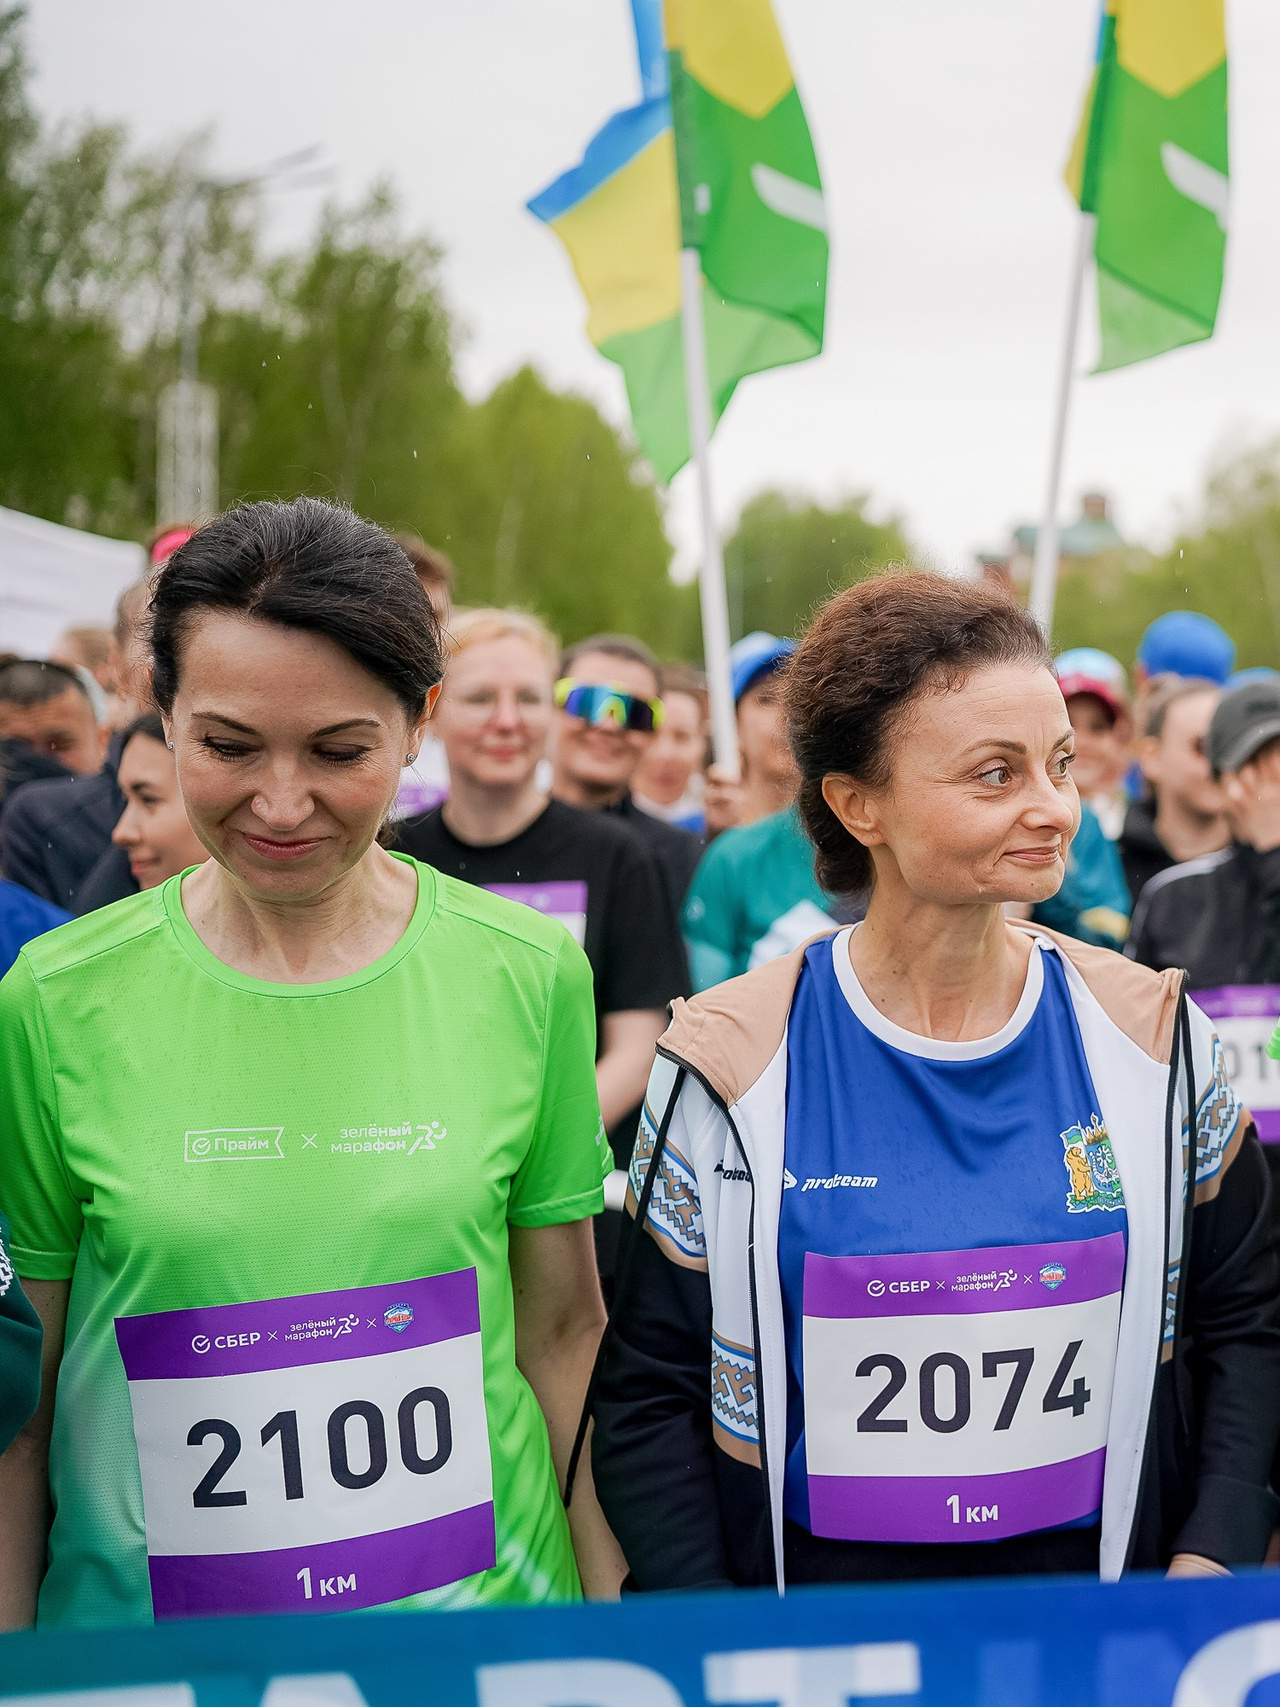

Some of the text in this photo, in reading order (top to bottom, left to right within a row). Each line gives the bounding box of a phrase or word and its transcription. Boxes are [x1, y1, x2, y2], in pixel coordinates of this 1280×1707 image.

[339, 1121, 412, 1139] зелёный
[214, 1136, 270, 1152] Прайм
[330, 1138, 407, 1155] марафон
[801, 1173, 879, 1192] proteam
[955, 1270, 998, 1284] зелёный
[888, 1280, 931, 1294] СБЕР
[950, 1281, 995, 1295] марафон
[289, 1316, 337, 1332] зелёный
[214, 1331, 261, 1349] СБЕР
[284, 1328, 333, 1342] марафон
[854, 1339, 1092, 1434] 2074
[185, 1386, 454, 1509] 2100
